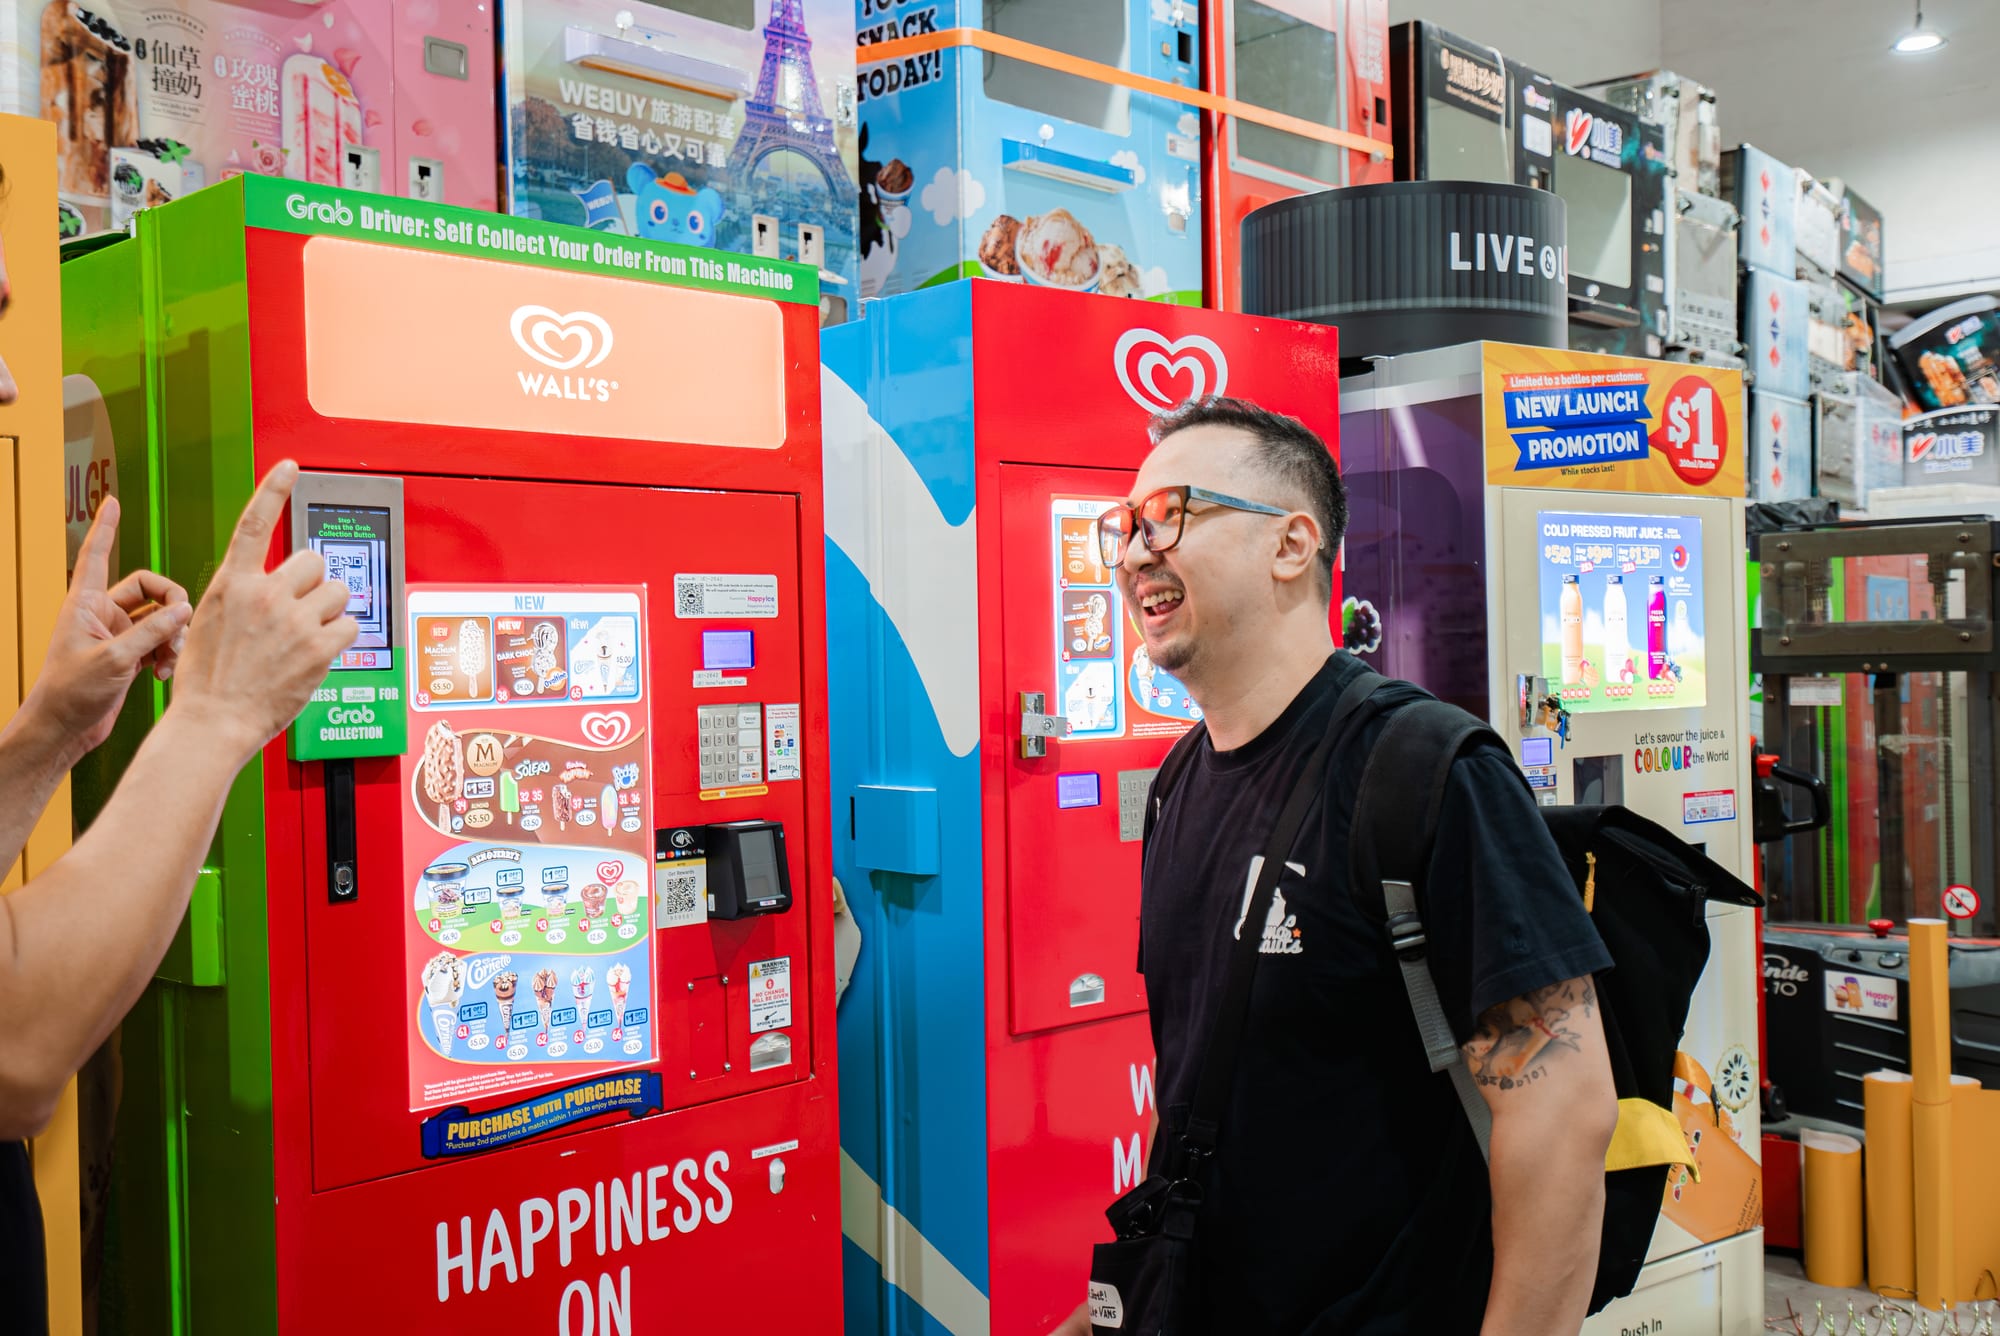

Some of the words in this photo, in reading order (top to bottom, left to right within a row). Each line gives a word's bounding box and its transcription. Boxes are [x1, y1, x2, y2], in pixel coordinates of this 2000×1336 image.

[857, 8, 936, 47] SNACK
[152, 40, 201, 71] 仙草
[231, 58, 279, 91] 玫瑰
[857, 49, 940, 102] TODAY!
[152, 66, 201, 99] 撞奶
[232, 85, 279, 116] 蜜桃
[559, 78, 648, 119] WEBUY
[286, 193, 353, 226] Grab
[360, 205, 429, 239] Driver:
[434, 217, 474, 244] Self
[477, 224, 545, 255] Collect
[549, 234, 589, 262] Your
[593, 242, 642, 269] Order
[645, 251, 687, 277] From
[690, 256, 724, 282] This
[727, 262, 793, 291] Machine
[1451, 232, 1534, 275] LIVE
[1510, 376, 1542, 388] Limited
[1544, 377, 1552, 386] to
[1554, 378, 1560, 386] 2
[1561, 373, 1591, 386] bottles
[1591, 376, 1604, 387] per
[1606, 372, 1645, 383] customer.
[1515, 395, 1562, 420] NEW
[1564, 391, 1639, 416] LAUNCH
[1668, 387, 1719, 460] $1
[1528, 431, 1640, 461] PROMOTION
[1937, 434, 1982, 457] 小美
[1561, 466, 1578, 477] While
[1580, 464, 1600, 476] stocks
[1602, 463, 1616, 474] last!
[64, 458, 111, 524] ULGE
[1079, 502, 1098, 513] NEW
[318, 530, 353, 538] Collection
[323, 523, 342, 531] Press
[355, 524, 371, 532] Grab
[1543, 524, 1570, 538] COLD
[1571, 525, 1612, 539] PRESSED
[1613, 527, 1638, 539] FRUIT
[1639, 528, 1664, 540] JUICE
[514, 595, 545, 610] NEW
[433, 627, 449, 637] NEW
[498, 620, 522, 631] NEW
[497, 652, 516, 661] DARK
[544, 671, 569, 688] Ovaltine
[432, 682, 452, 691] $5.50
[379, 688, 399, 701] FOR
[418, 692, 429, 705] 33
[571, 690, 581, 699] 65
[328, 705, 375, 725] Grab
[320, 726, 383, 741] COLLECTION
[1635, 733, 1655, 746] Let's
[1657, 731, 1684, 744] savour
[1686, 729, 1699, 742] the
[1699, 728, 1719, 743] juice
[1720, 729, 1725, 739] &
[475, 743, 495, 762] M
[1635, 745, 1692, 774] COLOUR
[1692, 752, 1705, 764] the
[1707, 750, 1729, 762] World
[515, 760, 550, 780] SOLERO
[520, 791, 530, 802] 32
[532, 790, 543, 801] 35
[619, 795, 627, 805] 31
[455, 800, 466, 811] 34
[468, 813, 490, 824] $5.50
[523, 817, 540, 828] $3.50
[578, 812, 594, 822] $3.50
[624, 819, 639, 829] $3.50
[498, 873, 508, 883] $1
[544, 870, 553, 880] $1
[466, 892, 476, 902] $1
[430, 919, 440, 932] 41
[491, 920, 502, 933] 42
[761, 960, 787, 969] WARNING
[467, 954, 512, 989] Cornetto
[764, 988, 785, 996] CHANGE
[1773, 981, 1798, 997] 10
[1866, 989, 1895, 1002] Happy
[463, 1007, 472, 1018] $1
[553, 1012, 562, 1022] $1
[590, 1014, 598, 1024] $1
[626, 1012, 634, 1022] $1
[514, 1015, 523, 1026] $1
[457, 1026, 467, 1038] 61
[574, 1031, 585, 1043] 63
[613, 1028, 622, 1040] 66
[470, 1037, 487, 1047] $5.00
[495, 1037, 506, 1049] 64
[537, 1034, 547, 1046] 62
[509, 1048, 526, 1058] $5.00
[447, 1107, 532, 1140] PURCHASE
[533, 1098, 562, 1118] WITH
[564, 1078, 642, 1110] PURCHASE
[477, 1136, 489, 1146] 2nd
[490, 1133, 506, 1144] piece
[507, 1129, 521, 1138] (mix
[522, 1126, 527, 1134] &
[528, 1119, 548, 1132] match)
[549, 1112, 567, 1124] within
[572, 1106, 584, 1117] min
[585, 1105, 591, 1113] to
[592, 1101, 608, 1111] enjoy
[608, 1098, 618, 1106] the
[618, 1096, 644, 1105] discount.
[436, 1150, 733, 1302] HAPPINESS
[559, 1265, 632, 1336] ON
[1099, 1305, 1117, 1319] VANS
[1621, 1321, 1648, 1336] Push
[1651, 1318, 1662, 1333] In
